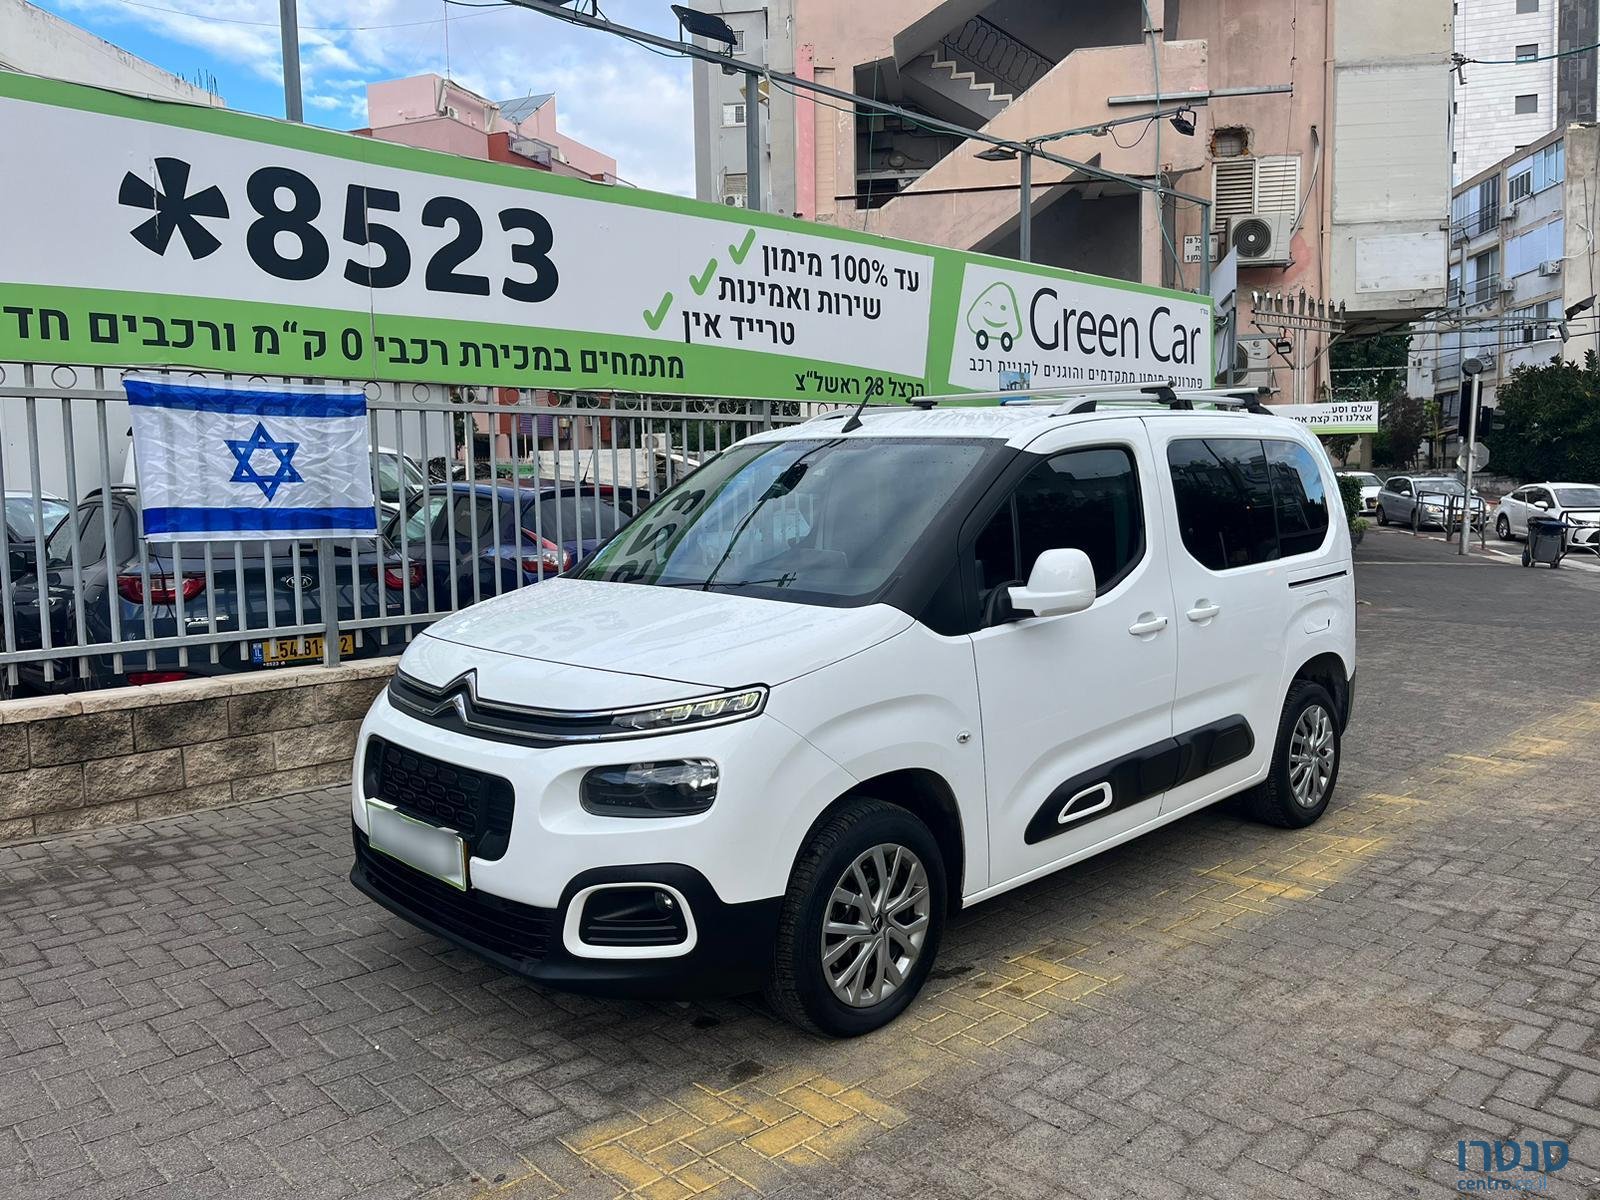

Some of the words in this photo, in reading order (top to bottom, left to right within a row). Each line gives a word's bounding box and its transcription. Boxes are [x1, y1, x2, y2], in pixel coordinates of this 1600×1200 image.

[762, 244, 822, 277] מימון
[831, 253, 888, 287] 100%
[718, 276, 810, 311] ואמינות
[894, 267, 919, 292] עד
[817, 289, 881, 320] שירות
[3, 306, 69, 341] חד
[89, 312, 236, 352] ורכבים
[682, 310, 721, 343] אין
[730, 316, 795, 346] טרייד
[1030, 287, 1139, 358] Green
[1149, 306, 1201, 365] Car
[341, 327, 363, 361] 0
[374, 336, 448, 366] רכבי
[459, 341, 571, 372] במכירת
[580, 350, 684, 379] מתמחים
[969, 357, 993, 373] רכב
[1044, 364, 1084, 379] והוגנים
[1088, 368, 1136, 384] מתקדמים
[864, 376, 884, 396] 28
[889, 377, 925, 398] הרצל
[1309, 415, 1330, 424] קצת
[1346, 413, 1372, 422] אצלנו
[1351, 404, 1373, 413] שלם
